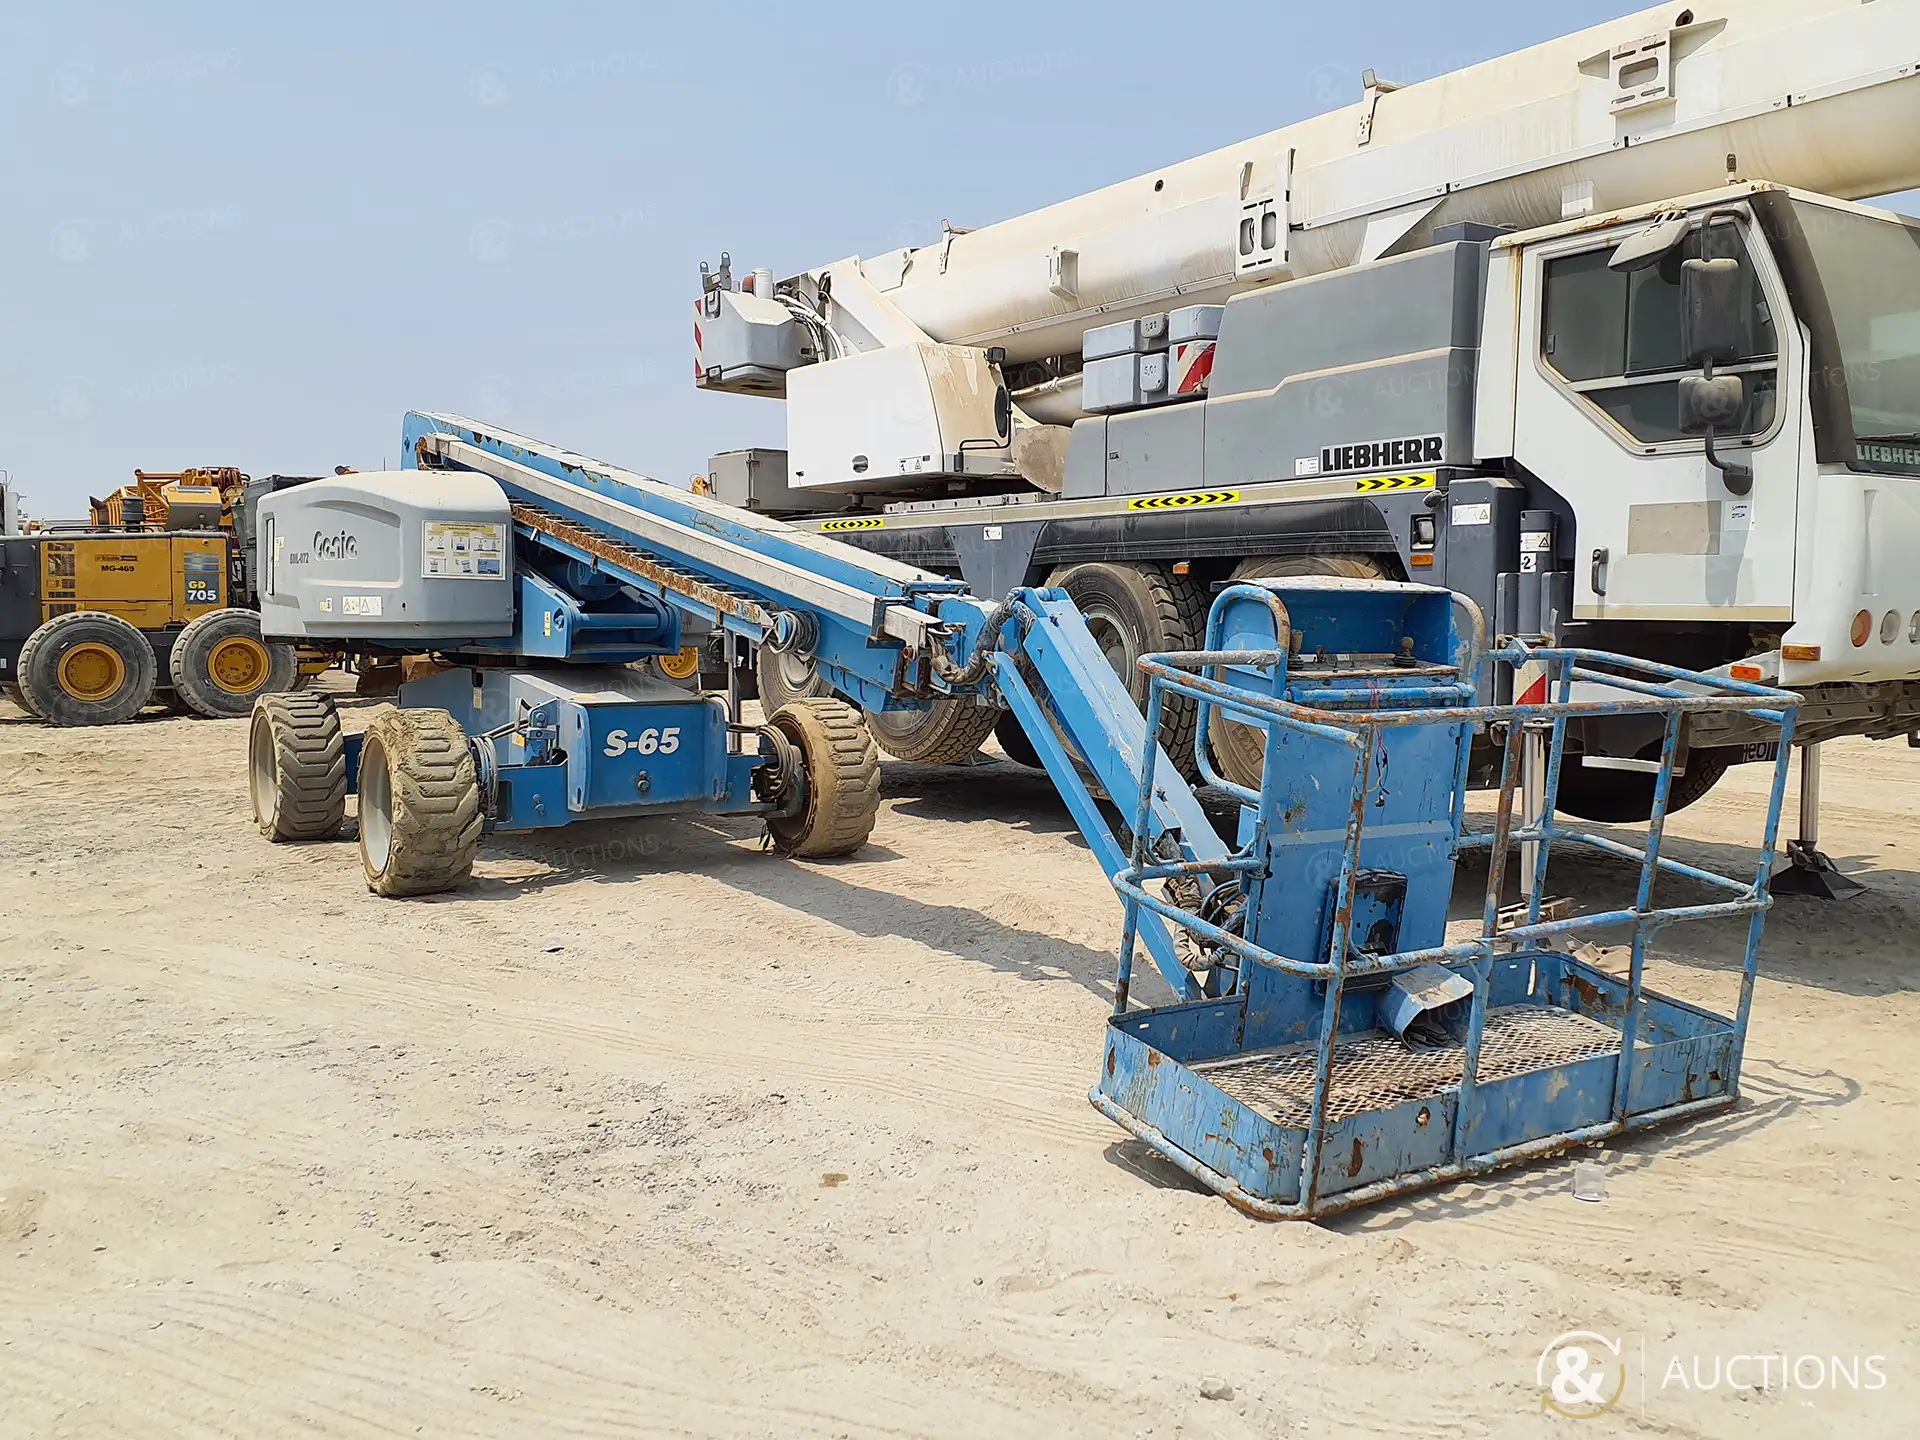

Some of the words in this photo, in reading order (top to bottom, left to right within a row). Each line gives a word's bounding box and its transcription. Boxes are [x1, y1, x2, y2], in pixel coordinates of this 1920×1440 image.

[1322, 436, 1443, 472] LIEBHERR
[1523, 556, 1531, 570] 2
[188, 580, 206, 589] GD
[187, 590, 217, 601] 705
[603, 727, 681, 757] S-65
